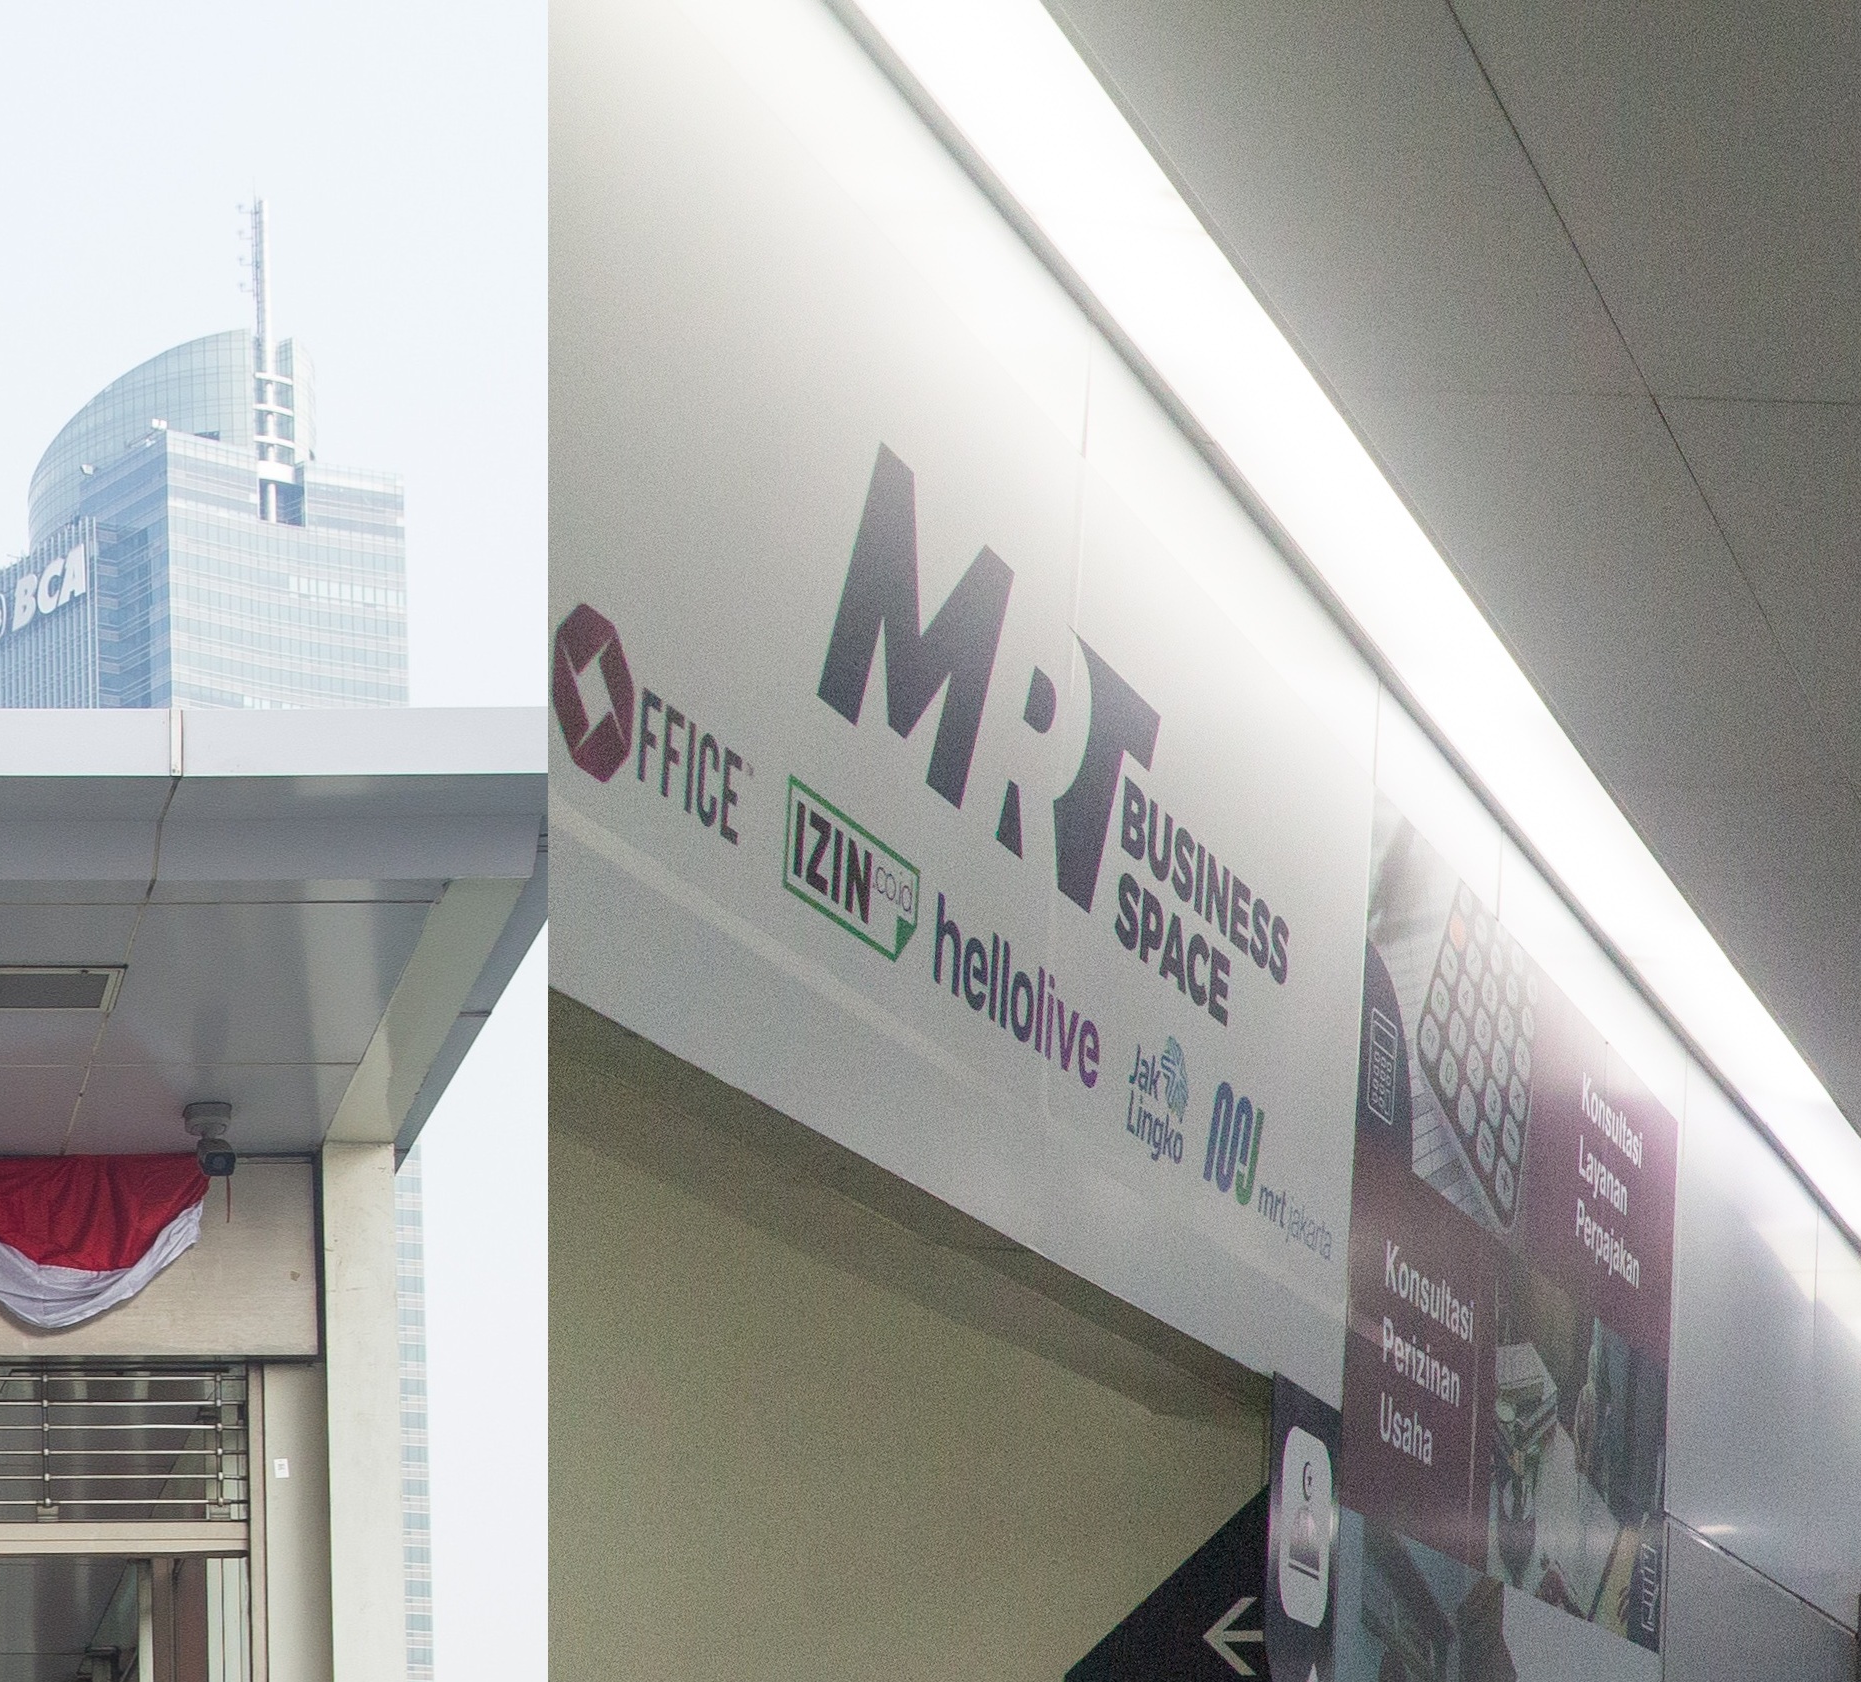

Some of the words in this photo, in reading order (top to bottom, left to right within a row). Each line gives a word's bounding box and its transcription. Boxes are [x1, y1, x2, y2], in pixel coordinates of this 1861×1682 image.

[11, 543, 87, 632] BCA
[817, 441, 1161, 914] MRT
[1120, 776, 1291, 986] BUSINESS
[935, 893, 1101, 1089] hellolive
[1114, 872, 1232, 1027] SPACE
[1128, 1043, 1162, 1099] Jak
[1125, 1103, 1185, 1166] Lingko
[1582, 1072, 1643, 1169] Konsultasi
[1578, 1134, 1629, 1216] Layanan
[1575, 1199, 1640, 1289] Perpajakan
[1384, 1239, 1476, 1344] Konsultasi
[1381, 1316, 1461, 1408] Perizinan
[1379, 1400, 1434, 1466] Usaha
